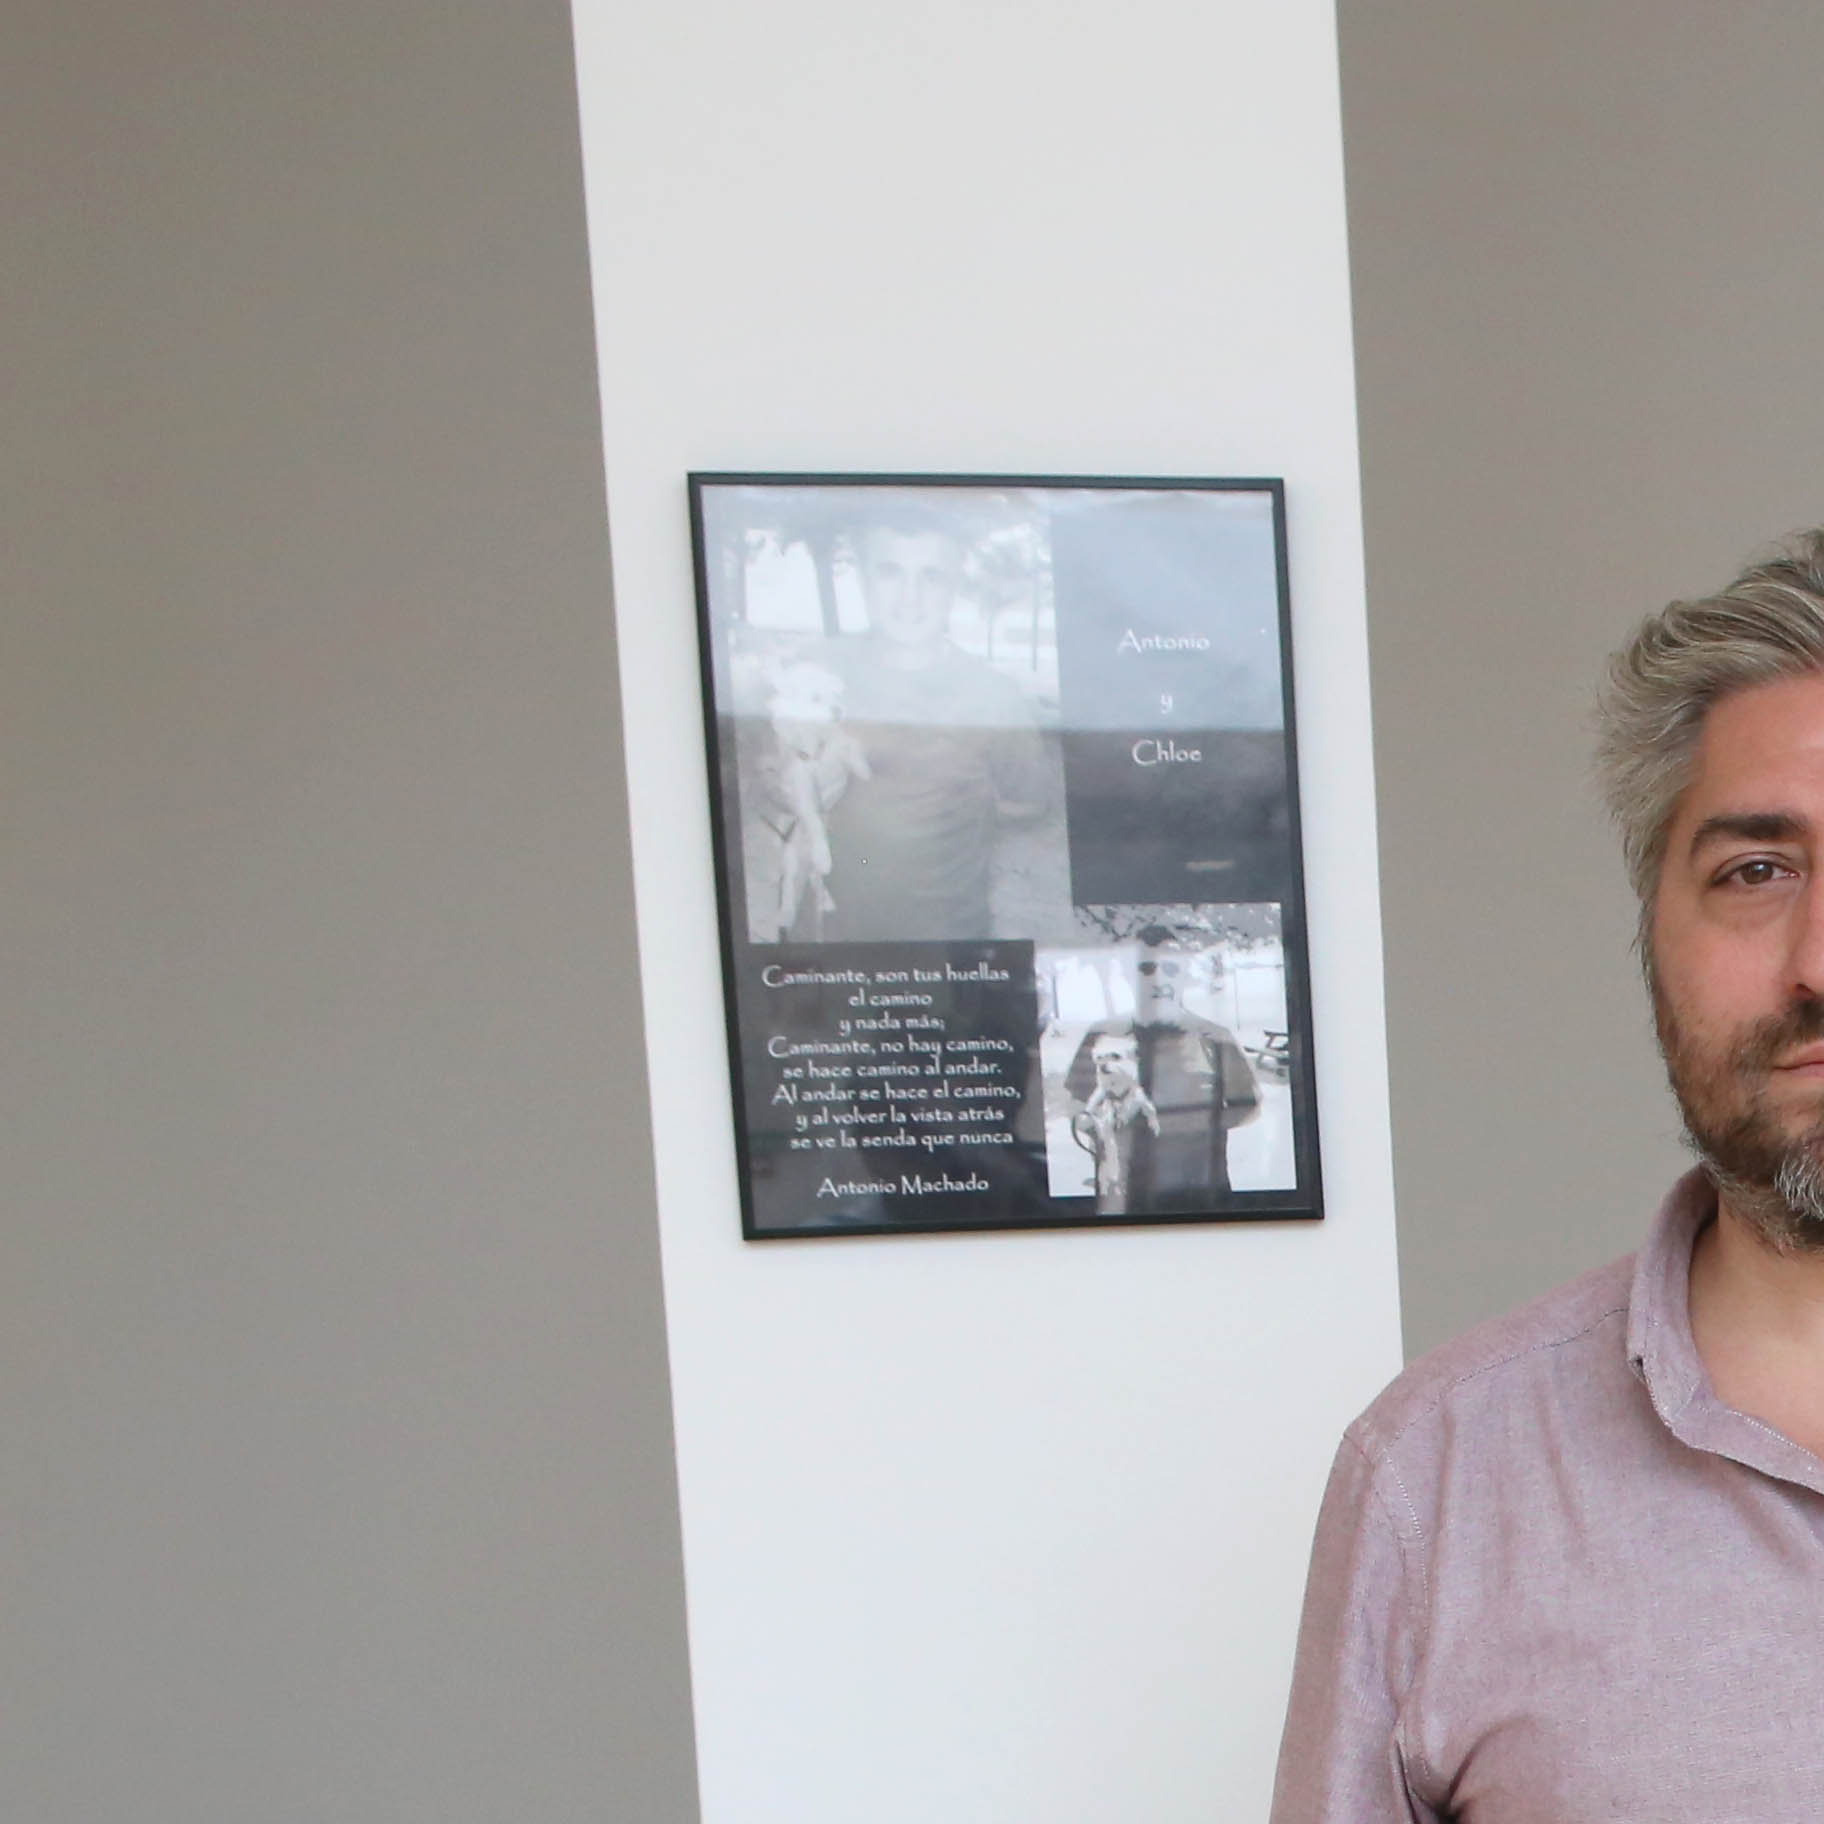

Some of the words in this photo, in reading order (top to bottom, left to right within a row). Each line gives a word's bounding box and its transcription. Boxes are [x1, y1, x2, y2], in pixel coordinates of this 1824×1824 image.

[1116, 629, 1211, 653] Antonio
[1160, 693, 1173, 713] y
[1131, 739, 1202, 766] Chloe
[762, 965, 871, 988] Caminante,
[875, 969, 909, 983] son
[913, 968, 942, 982] tus
[946, 962, 1010, 981] huellas
[848, 988, 865, 1006] el
[870, 989, 933, 1006] camino
[839, 1018, 851, 1036] y
[855, 1011, 901, 1029] nada
[906, 1014, 945, 1031] más;
[768, 1036, 876, 1059] Caminante,
[880, 1040, 904, 1053] no
[908, 1034, 942, 1058] hay
[946, 1035, 1014, 1052] camino,
[783, 1067, 804, 1079] se
[808, 1060, 852, 1079] hace
[856, 1060, 920, 1078] camino
[925, 1056, 940, 1076] al
[944, 1056, 1003, 1075] andar.
[771, 1083, 798, 1106] Al
[802, 1083, 856, 1102] andar
[860, 1088, 881, 1100] se
[884, 1081, 929, 1100] hace
[933, 1080, 950, 1099] el
[954, 1083, 1021, 1099] camino,
[795, 1114, 808, 1132] y
[812, 1106, 828, 1126] al
[832, 1105, 886, 1125] volver
[890, 1104, 907, 1123] la
[911, 1108, 954, 1122] vista
[958, 1106, 1005, 1121] atrás
[791, 1137, 811, 1149] se
[815, 1136, 836, 1148] ve
[840, 1130, 858, 1148] la
[862, 1128, 917, 1147] senda
[921, 1133, 955, 1152] que
[959, 1132, 1014, 1145] nunca
[816, 1177, 897, 1199] Antonio
[901, 1172, 990, 1195] Machado
